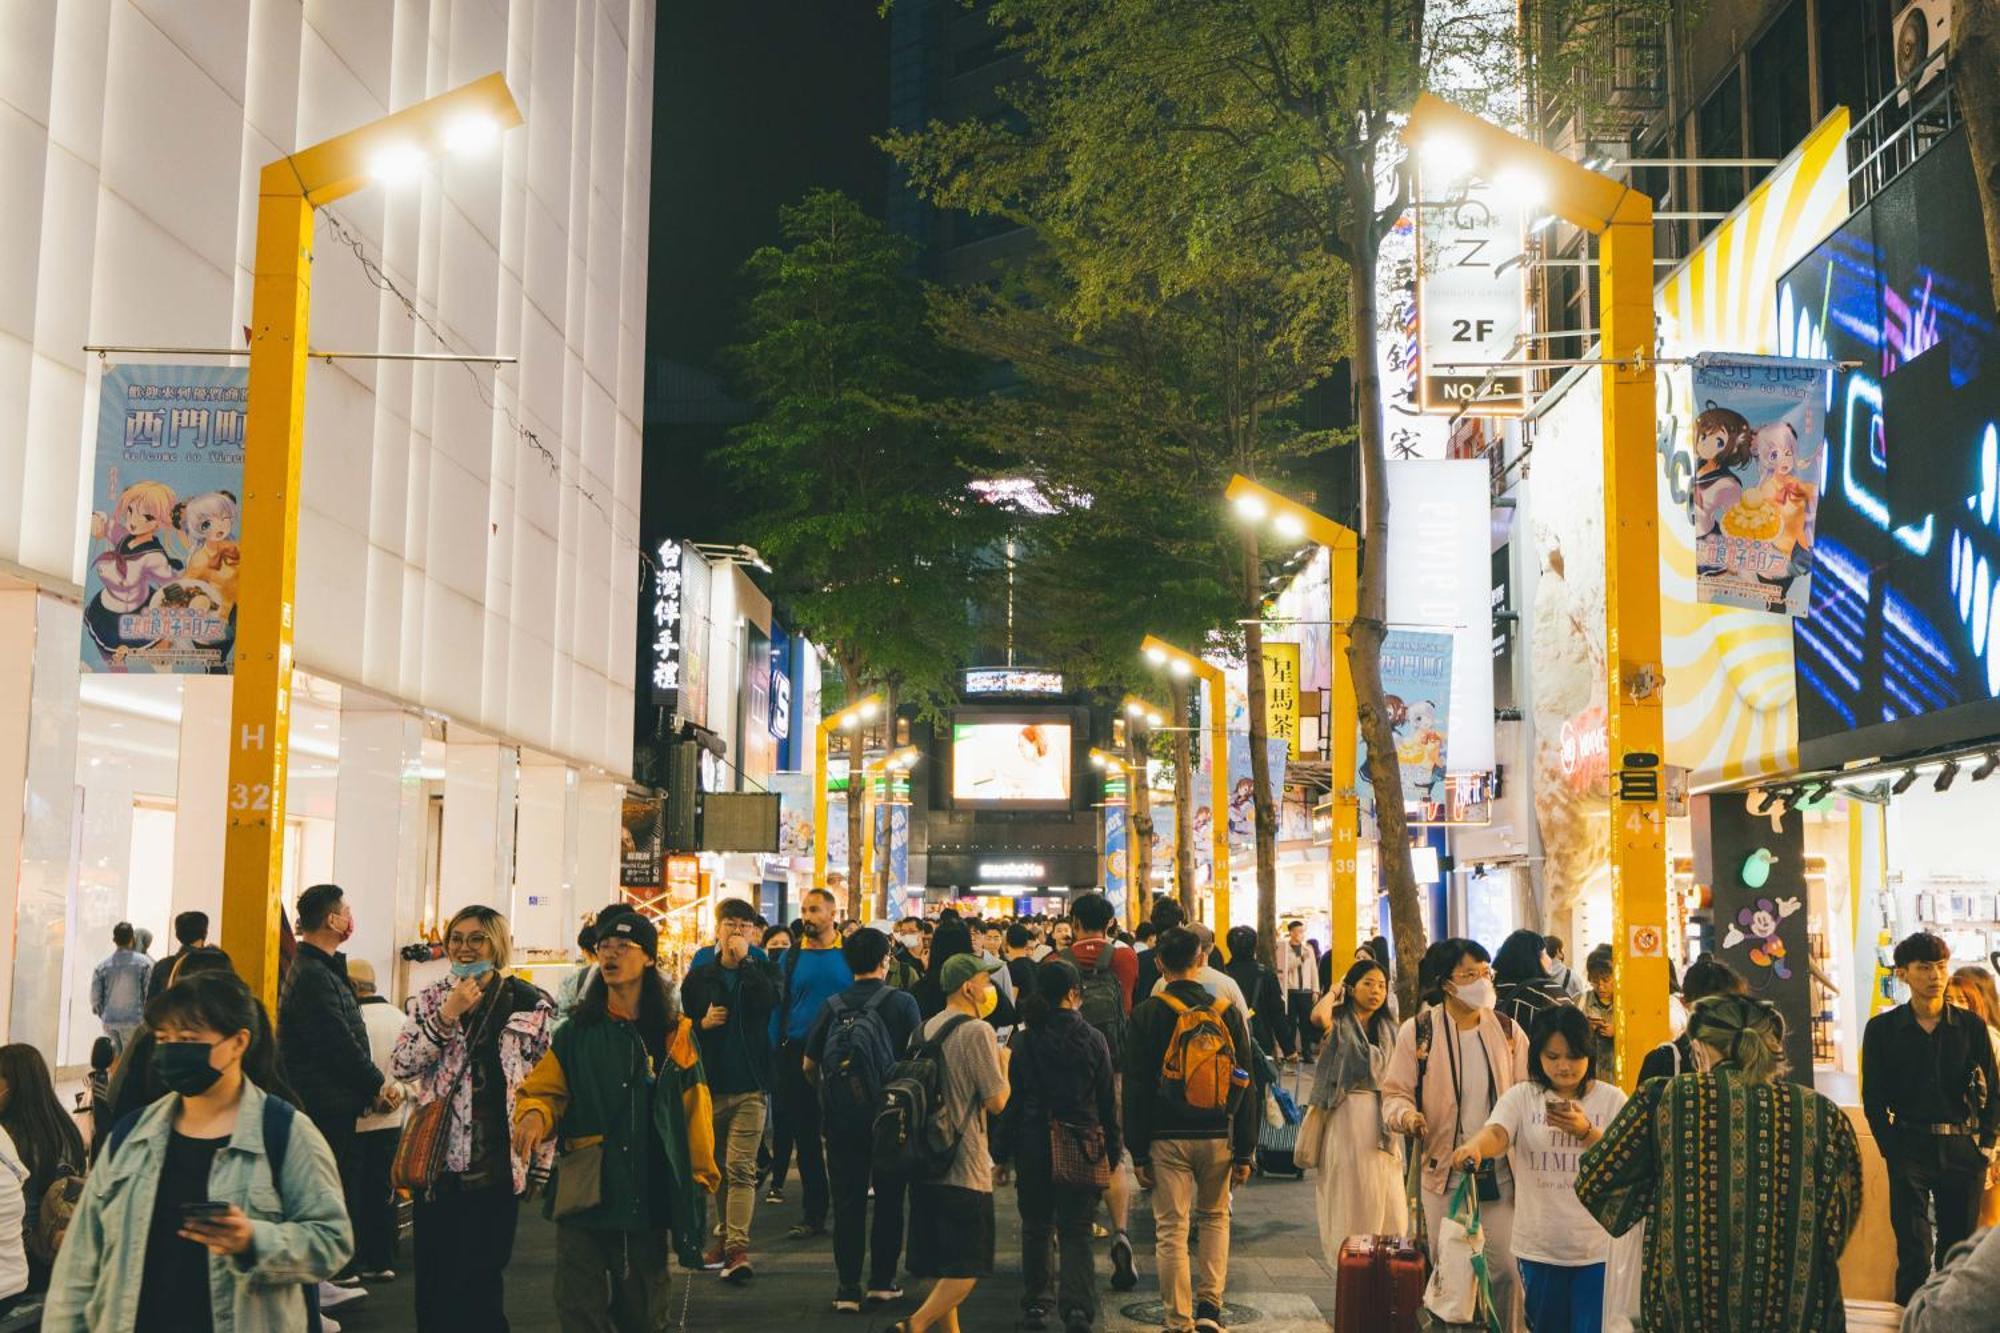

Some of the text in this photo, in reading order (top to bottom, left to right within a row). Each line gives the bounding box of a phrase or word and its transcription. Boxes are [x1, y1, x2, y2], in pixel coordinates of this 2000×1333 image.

[1451, 319, 1494, 342] 2F
[125, 407, 247, 449] 西門町
[185, 452, 202, 462] to
[653, 538, 681, 690] 台灣伴手禮
[1270, 657, 1294, 762] 星馬茶
[241, 724, 265, 751] H
[230, 783, 271, 811] 32
[1338, 828, 1353, 842] H
[1335, 861, 1356, 873] 39
